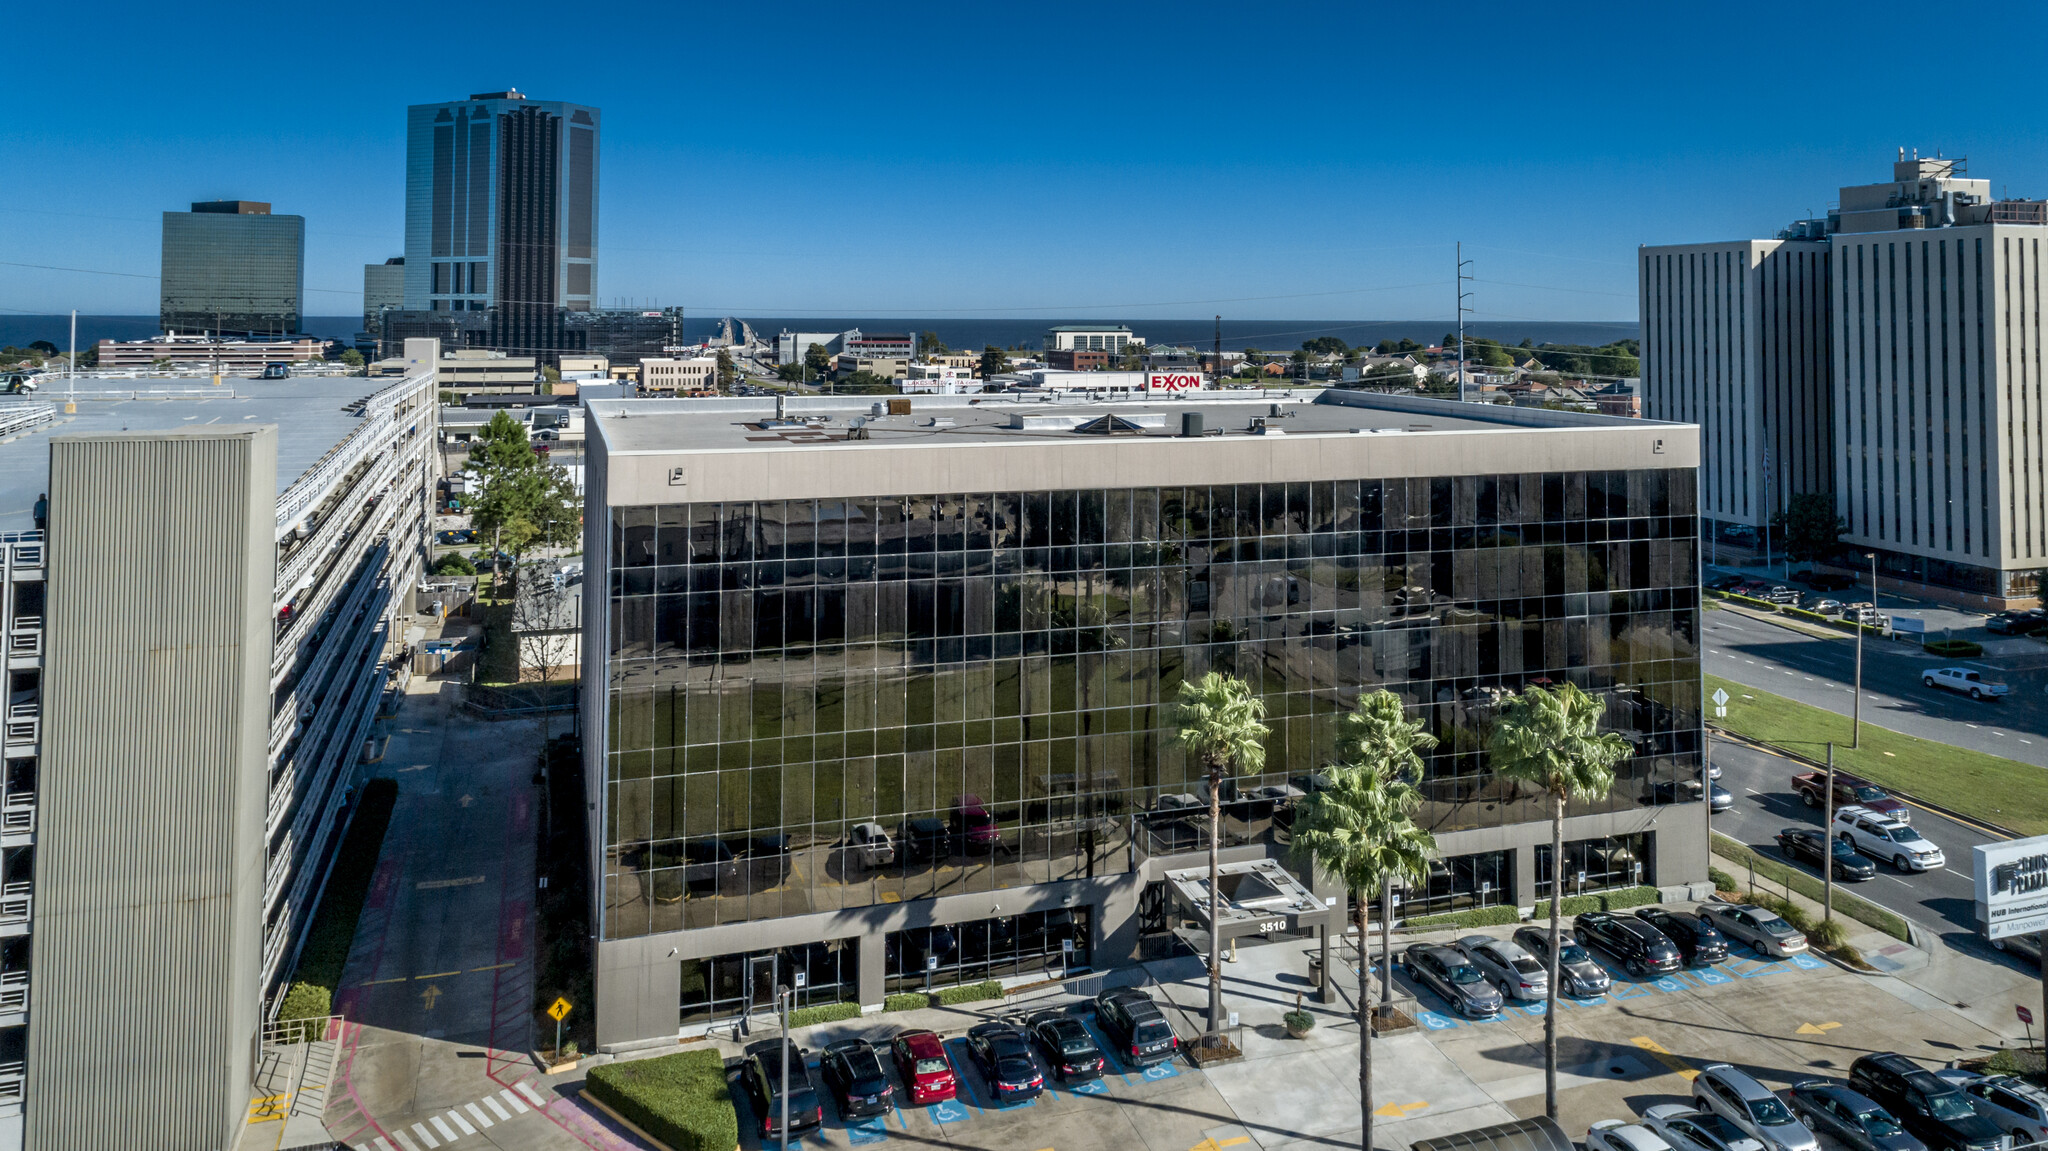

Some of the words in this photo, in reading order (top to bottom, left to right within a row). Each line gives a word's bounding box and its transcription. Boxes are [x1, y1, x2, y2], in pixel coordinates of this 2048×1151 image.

[1152, 374, 1200, 391] EXXON
[2018, 872, 2048, 894] PLAZA
[1991, 908, 2007, 918] HUB
[1260, 921, 1286, 932] 3510
[2007, 919, 2046, 931] Manpower
